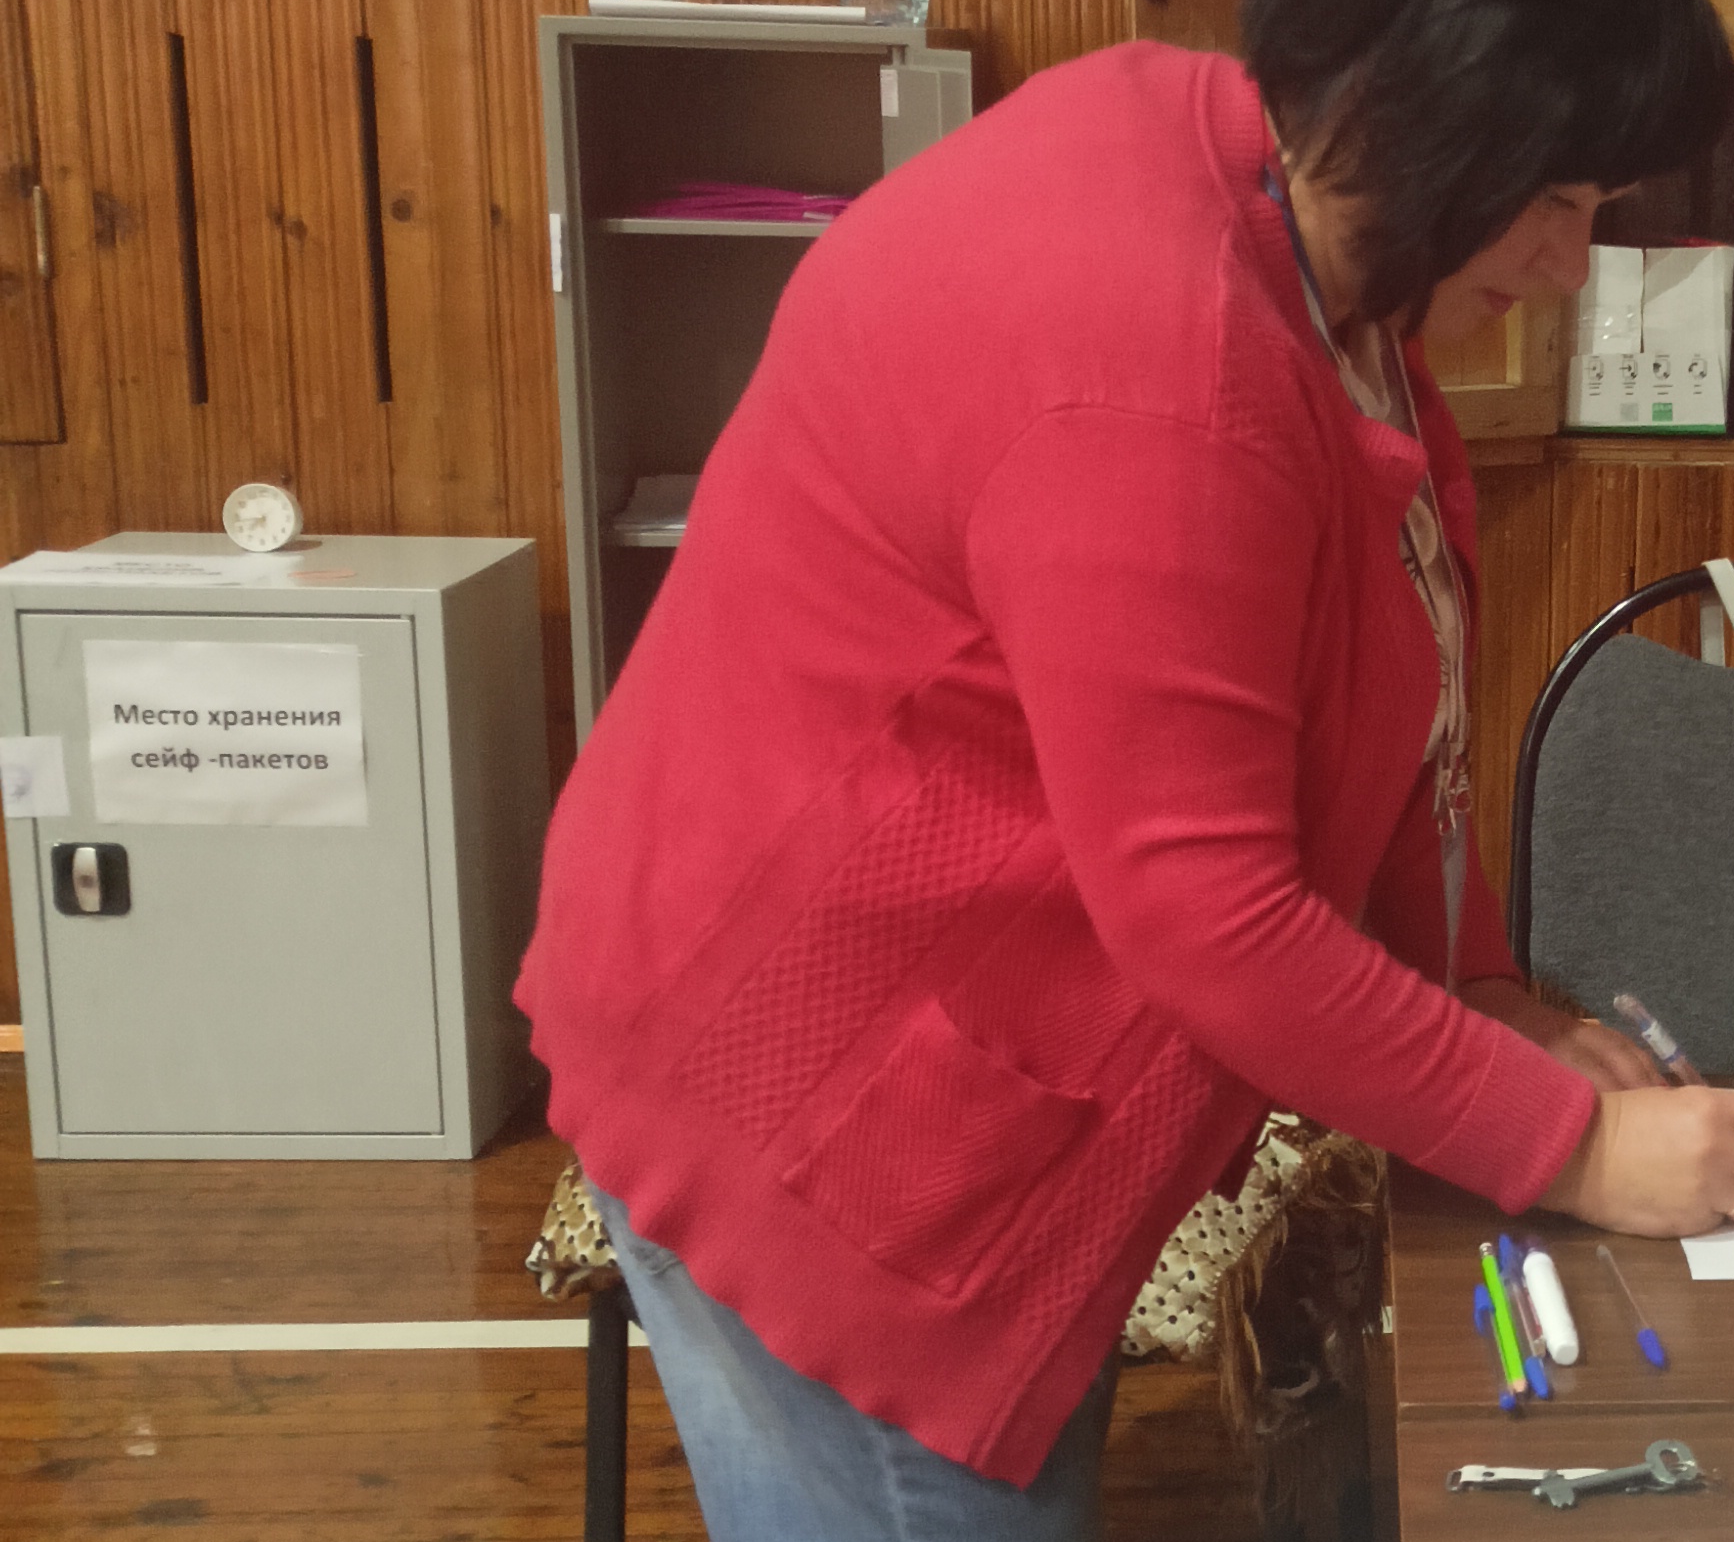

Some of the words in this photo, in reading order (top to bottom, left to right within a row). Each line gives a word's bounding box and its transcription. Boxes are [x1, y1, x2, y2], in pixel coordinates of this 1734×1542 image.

[113, 704, 199, 726] Место
[208, 709, 341, 731] хранения
[131, 746, 200, 772] сейф
[208, 753, 329, 770] -пакетов
